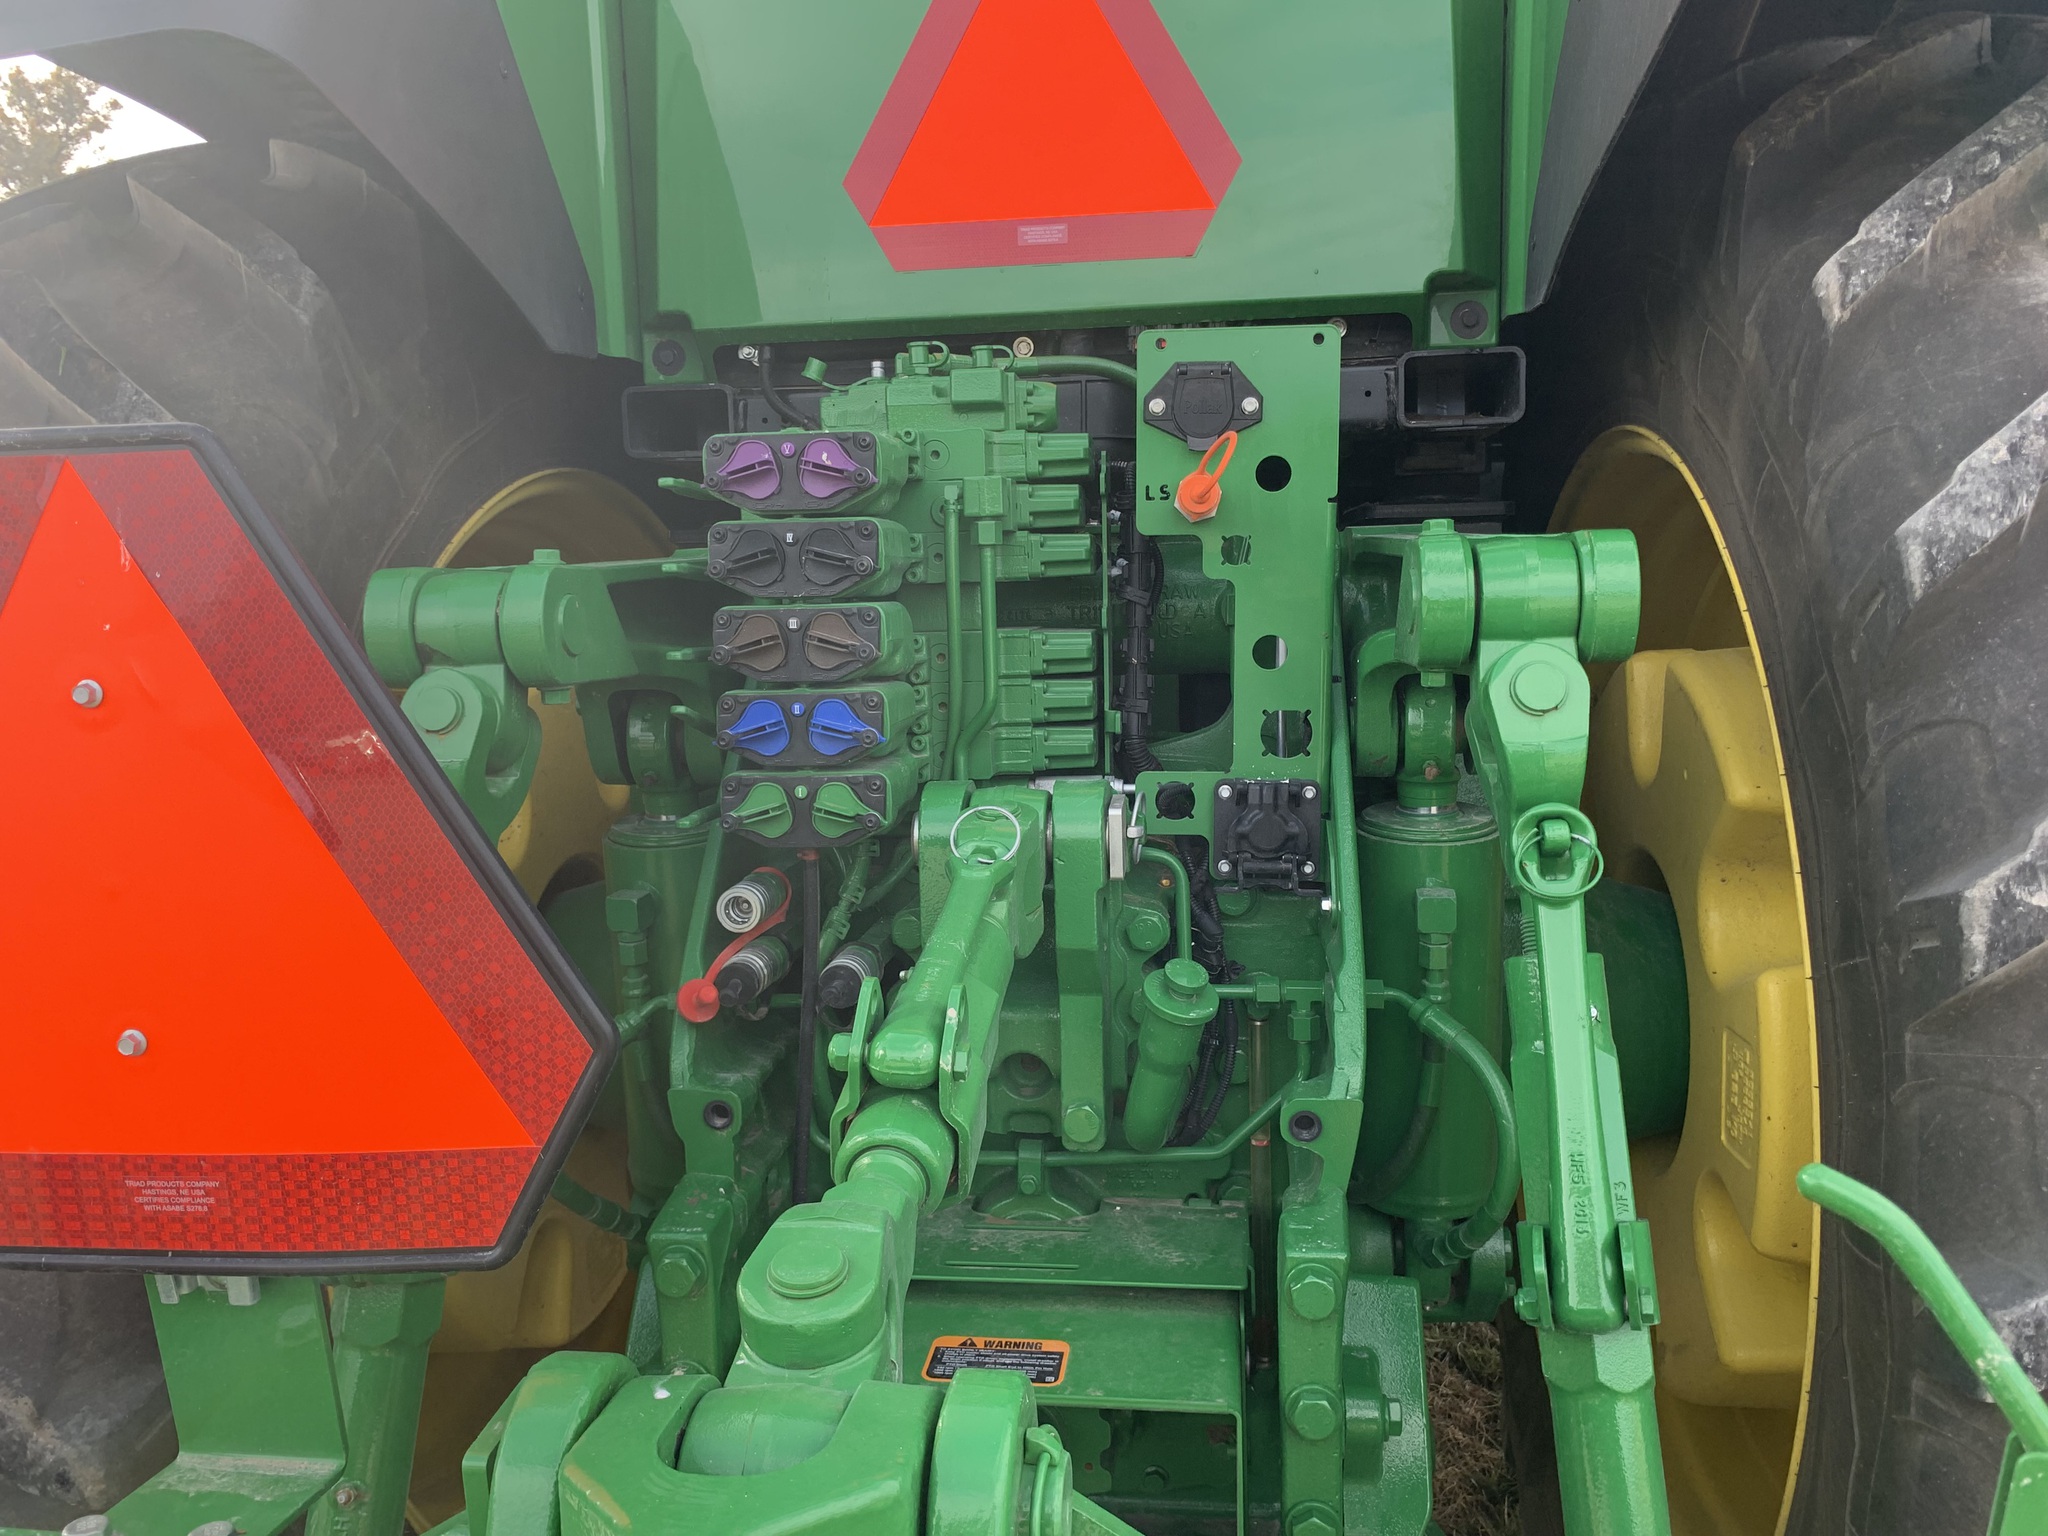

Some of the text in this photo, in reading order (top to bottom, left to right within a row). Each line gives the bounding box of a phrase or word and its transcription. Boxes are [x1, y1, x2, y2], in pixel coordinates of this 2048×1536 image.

[1184, 400, 1223, 415] Pollak
[186, 1180, 220, 1188] COMPANY
[142, 1188, 205, 1196] HASTINGS, NE USA
[134, 1196, 215, 1204] CERTIFIES COMPLIANCE
[144, 1204, 161, 1212] WITH
[162, 1204, 185, 1212] ASABE
[983, 1339, 1043, 1351] WARNING
